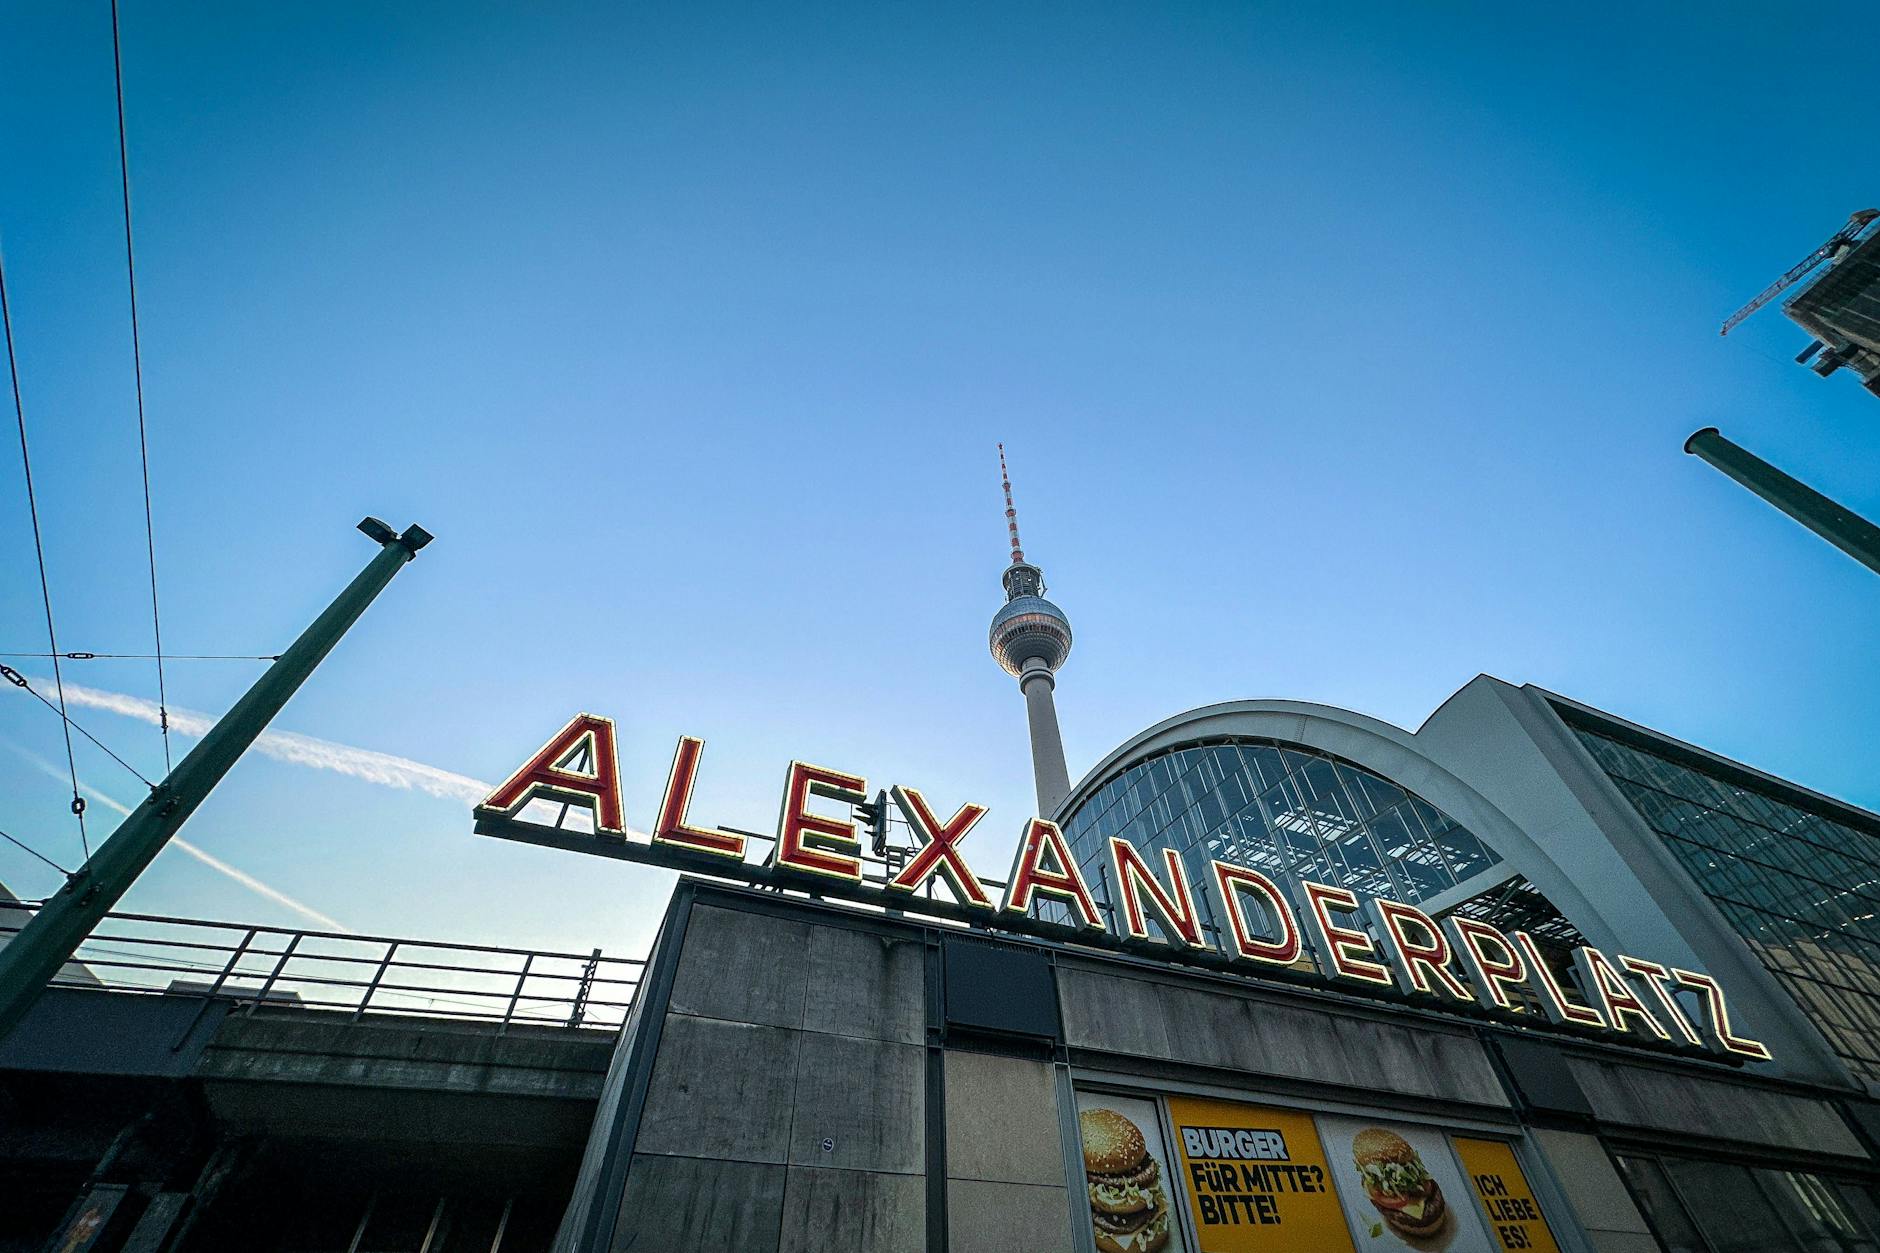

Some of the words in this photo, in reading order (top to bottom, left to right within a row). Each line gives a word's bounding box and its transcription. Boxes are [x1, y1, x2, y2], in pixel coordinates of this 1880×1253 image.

[475, 711, 1772, 1060] ALEXANDERPLATZ
[1181, 1127, 1289, 1160] BURGER
[1240, 1164, 1326, 1193] MITTE?
[1473, 1174, 1509, 1196] ICH
[1198, 1195, 1281, 1225] BITTE!
[1485, 1198, 1539, 1221] LIEBE
[1498, 1225, 1532, 1249] ES!
